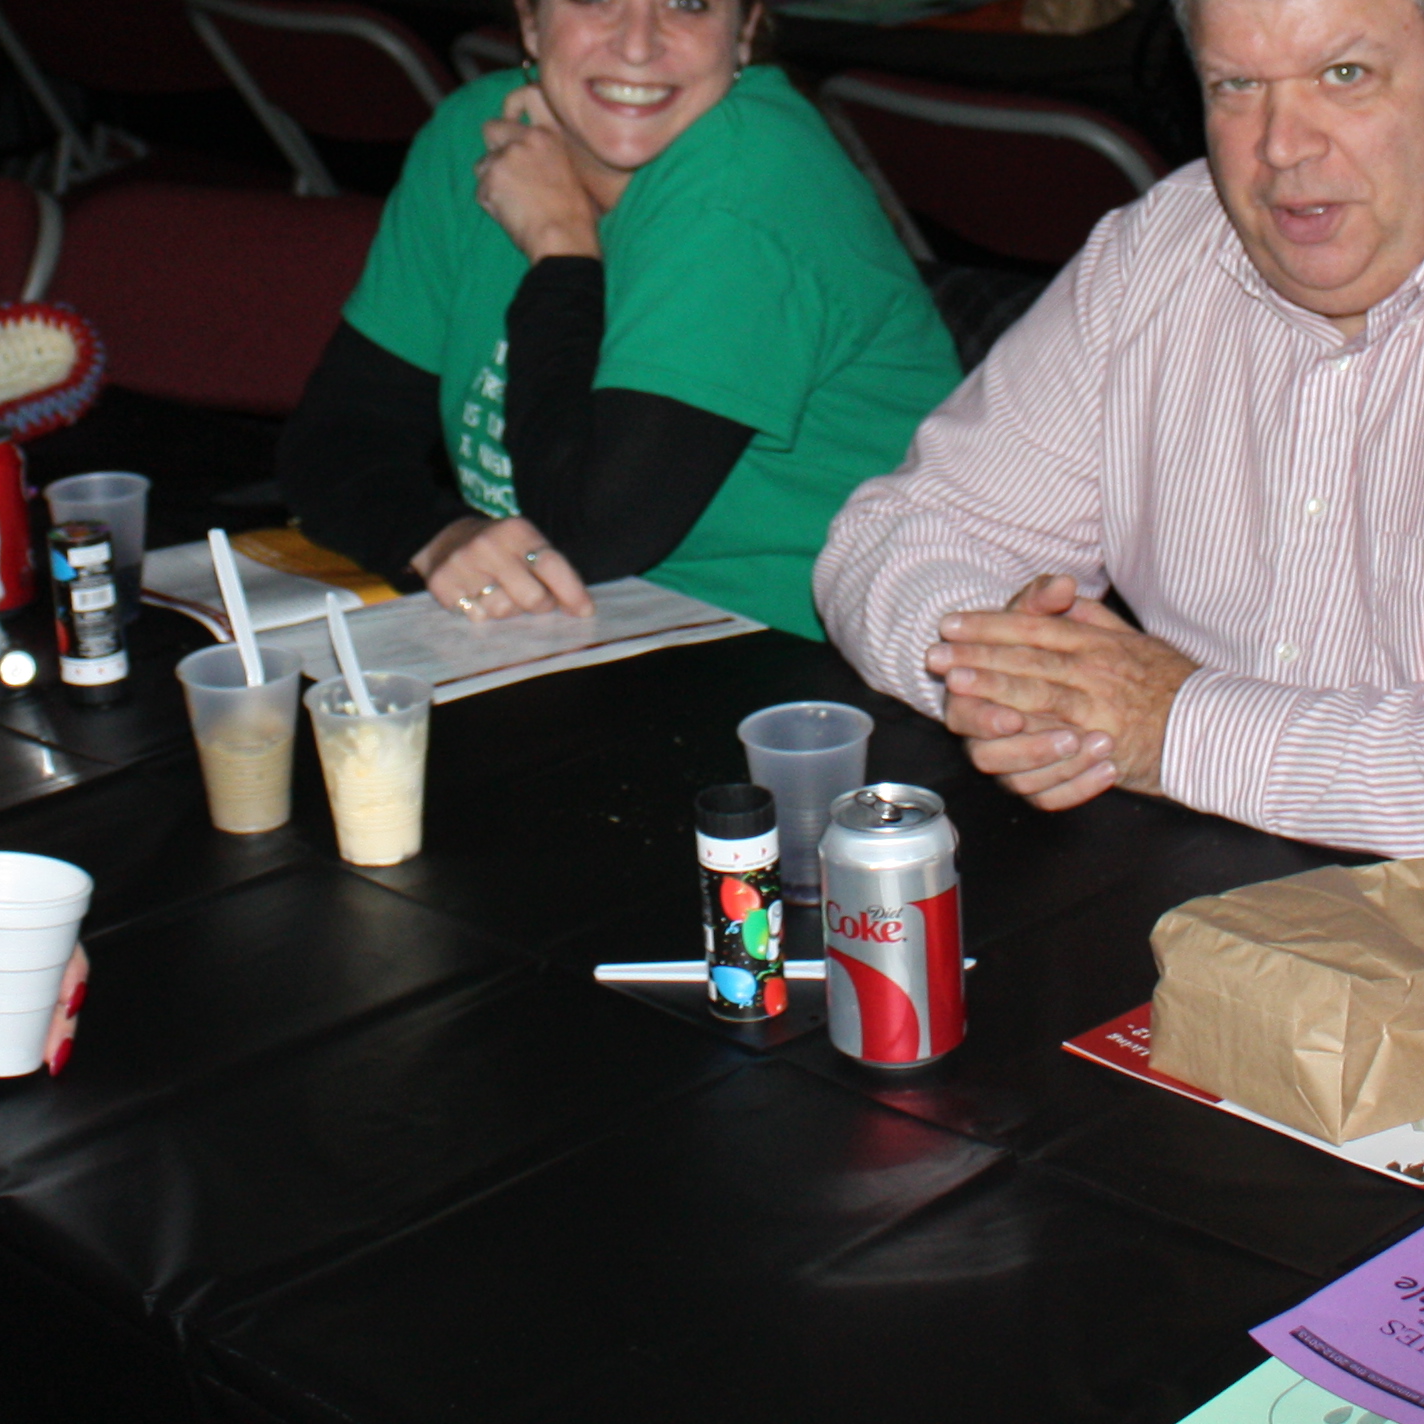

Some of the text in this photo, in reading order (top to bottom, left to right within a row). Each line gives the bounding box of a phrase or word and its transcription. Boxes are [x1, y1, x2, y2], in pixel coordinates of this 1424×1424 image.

[826, 899, 903, 943] Coke
[867, 903, 903, 919] Diet
[1105, 1032, 1151, 1057] Living
